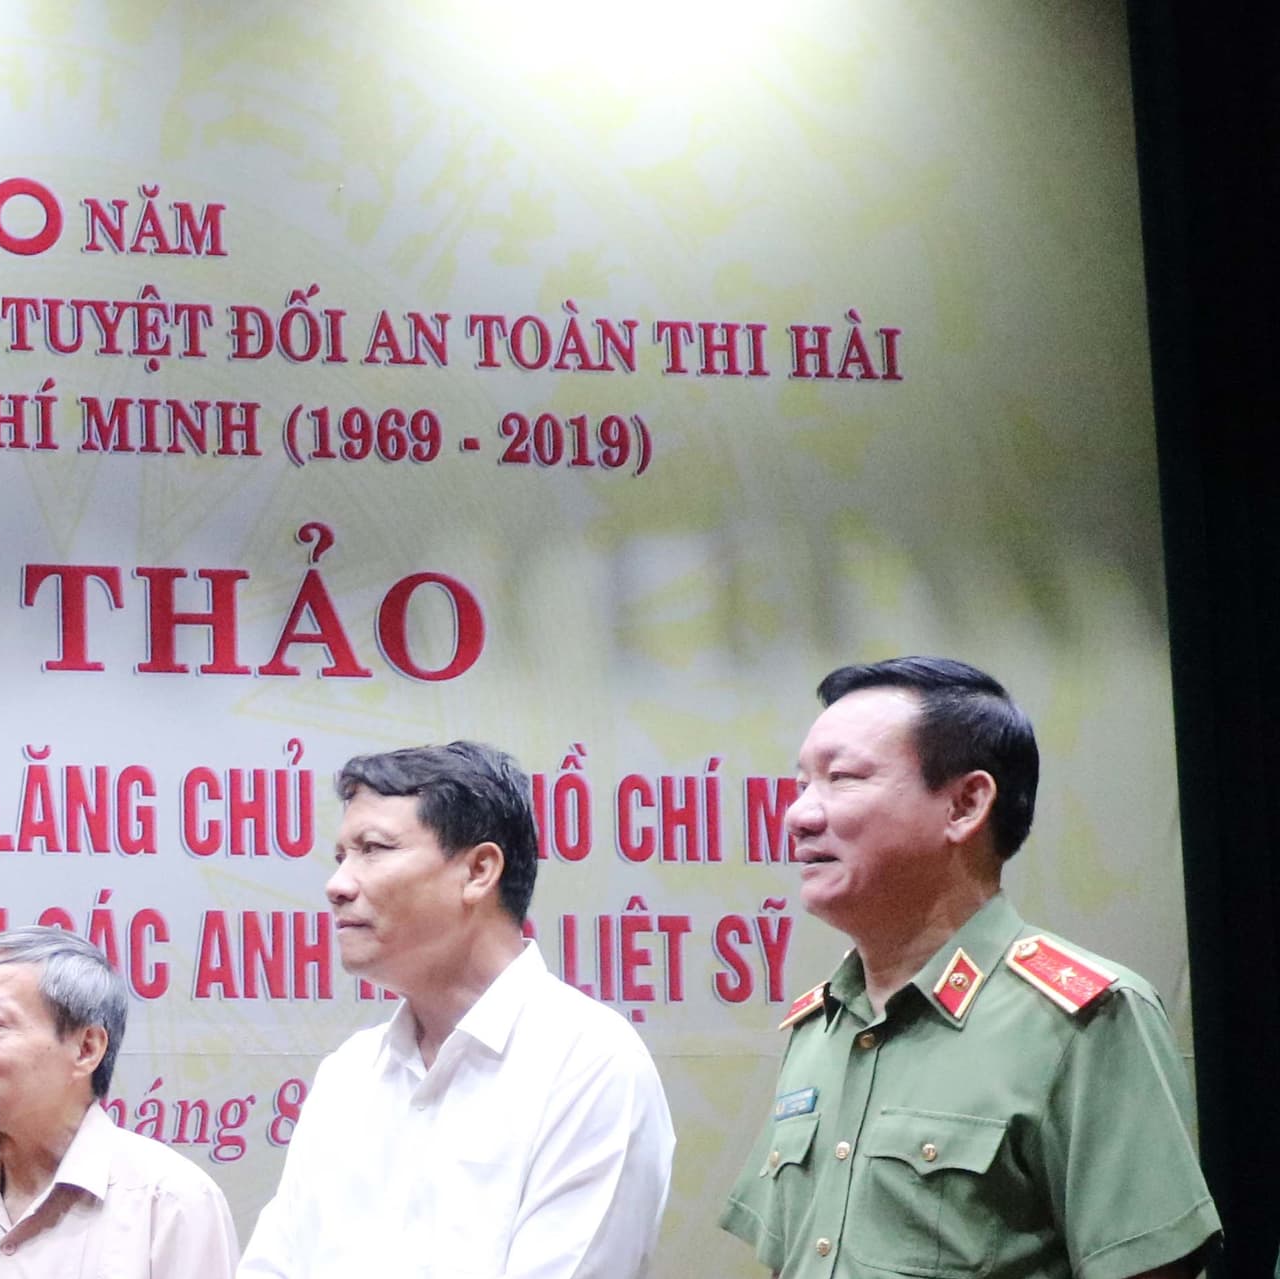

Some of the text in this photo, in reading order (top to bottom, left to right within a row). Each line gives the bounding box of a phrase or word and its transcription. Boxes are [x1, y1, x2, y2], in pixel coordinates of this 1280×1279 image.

[85, 187, 225, 256] NĂM
[1, 285, 213, 370] TUYỆT
[232, 284, 346, 362] ĐỐI
[366, 312, 450, 366] AN
[470, 300, 640, 372] TOÀN
[657, 320, 768, 376] THI
[791, 309, 900, 379] HÀI
[81, 396, 262, 456] MINH
[287, 406, 442, 461] (1969
[502, 412, 652, 468] 2019)
[23, 521, 486, 682] THẢO
[184, 738, 313, 858] CHỦ
[618, 757, 721, 862] CHÍ
[38, 889, 171, 1000] ÁC
[196, 910, 331, 999] ANH
[564, 895, 691, 1022] LIỆT
[716, 898, 792, 1002] SỸ
